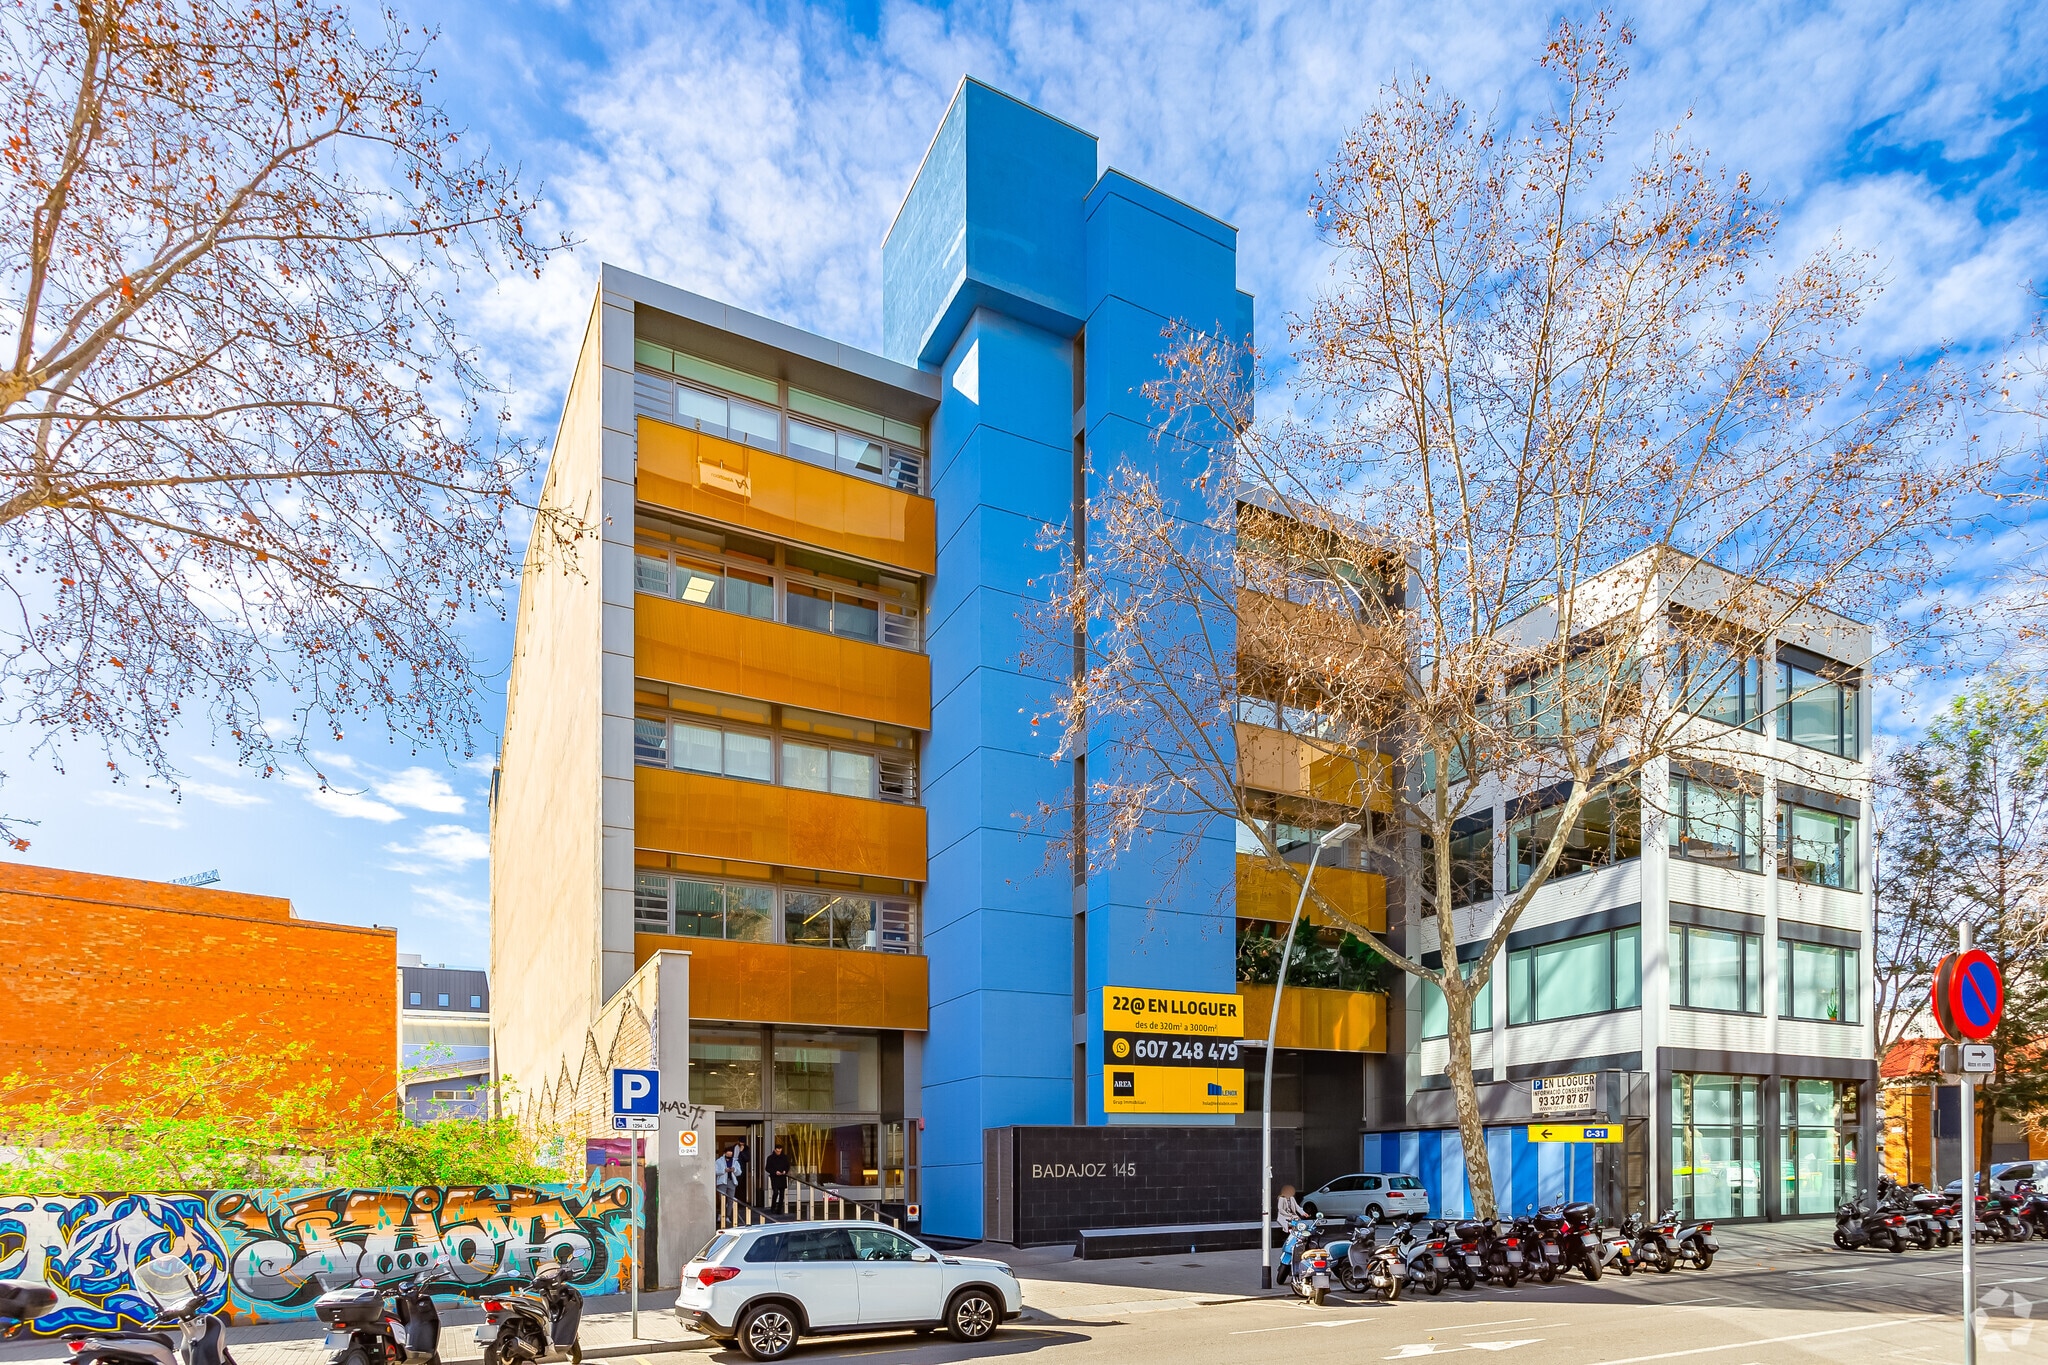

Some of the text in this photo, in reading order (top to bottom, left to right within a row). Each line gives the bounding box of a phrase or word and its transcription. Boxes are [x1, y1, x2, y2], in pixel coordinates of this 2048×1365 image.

[1112, 996, 1237, 1017] 22@ EN LLOGUER
[1135, 1021, 1148, 1029] des
[1149, 1021, 1158, 1029] de
[1160, 1022, 1182, 1031] 320m²
[1190, 1024, 1217, 1032] 3000m²
[1135, 1040, 1238, 1061] 607 248 479
[1535, 1075, 1595, 1089] P EN LLOGUER
[622, 1073, 651, 1110] P
[1539, 1093, 1589, 1106] 93 327 87 87
[1586, 1129, 1605, 1137] C-31
[1032, 1162, 1136, 1178] BADAJOZ 145
